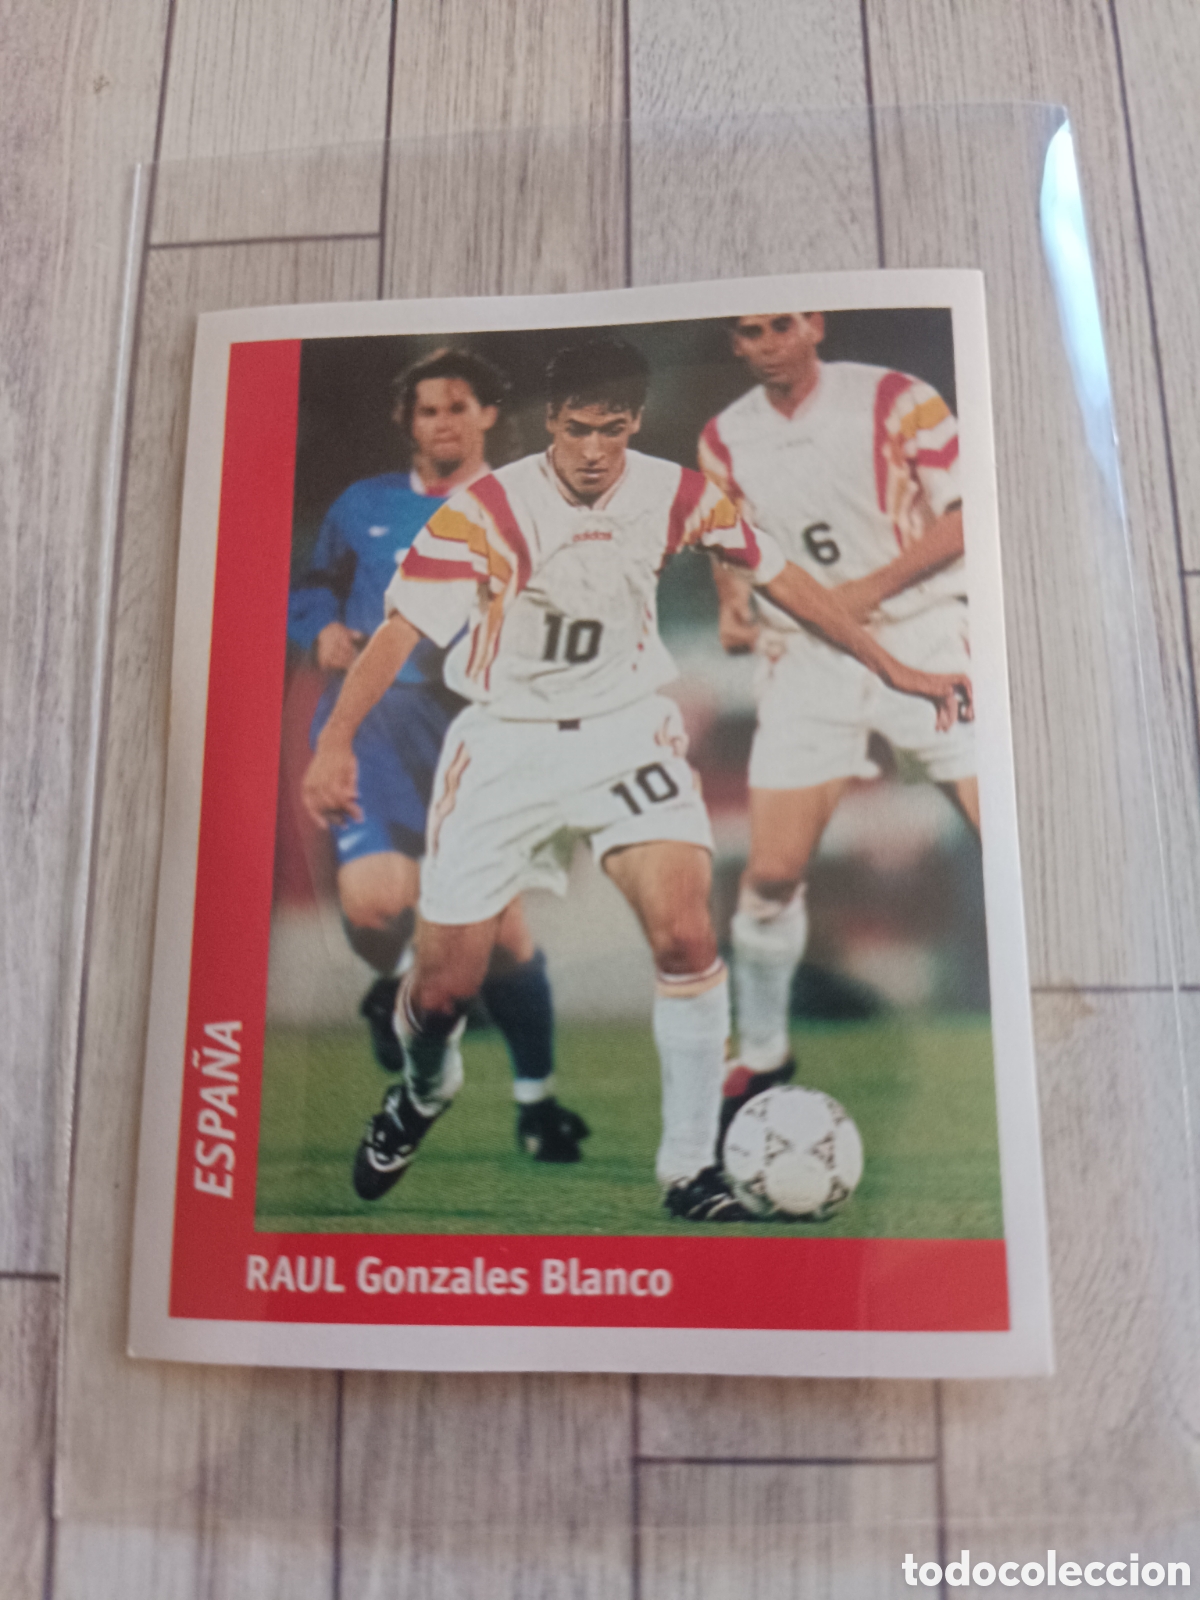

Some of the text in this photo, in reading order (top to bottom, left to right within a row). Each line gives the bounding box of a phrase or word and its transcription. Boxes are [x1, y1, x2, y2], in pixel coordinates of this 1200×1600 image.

[804, 523, 840, 565] 6
[542, 613, 603, 664] 10
[610, 762, 679, 815] 10
[193, 1020, 243, 1199] ESPAÑA
[246, 1255, 673, 1296] RAUL Gonzales Blanco
